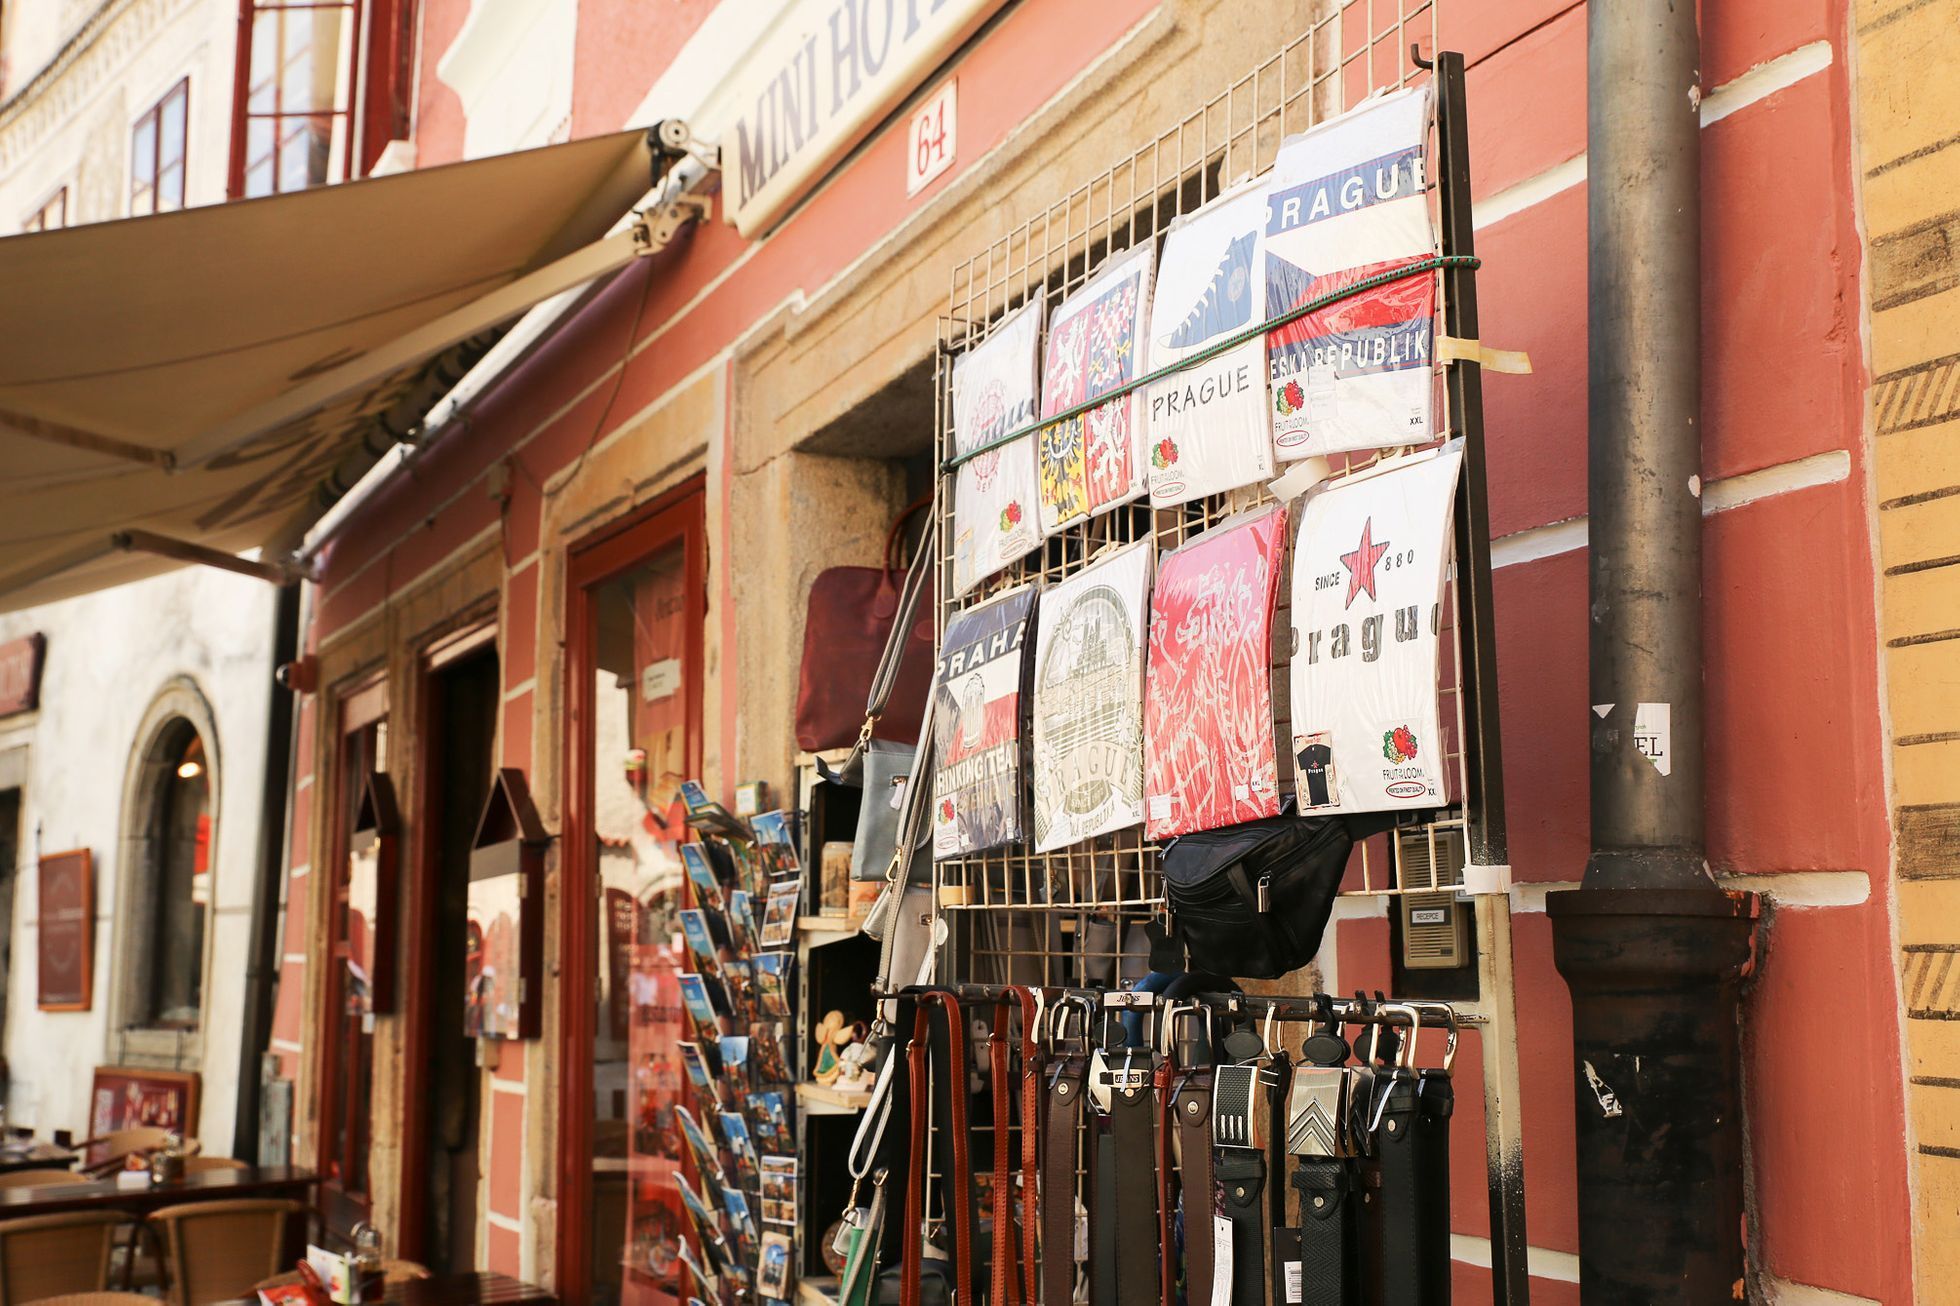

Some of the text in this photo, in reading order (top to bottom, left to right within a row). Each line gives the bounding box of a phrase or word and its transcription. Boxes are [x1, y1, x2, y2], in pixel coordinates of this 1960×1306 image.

[735, 34, 820, 211] MINI
[916, 100, 947, 177] 64
[1152, 364, 1250, 422] PRAGUE
[1315, 571, 1341, 592] SINCE
[1117, 994, 1141, 1003] JENS
[1115, 1073, 1139, 1084] JENS
